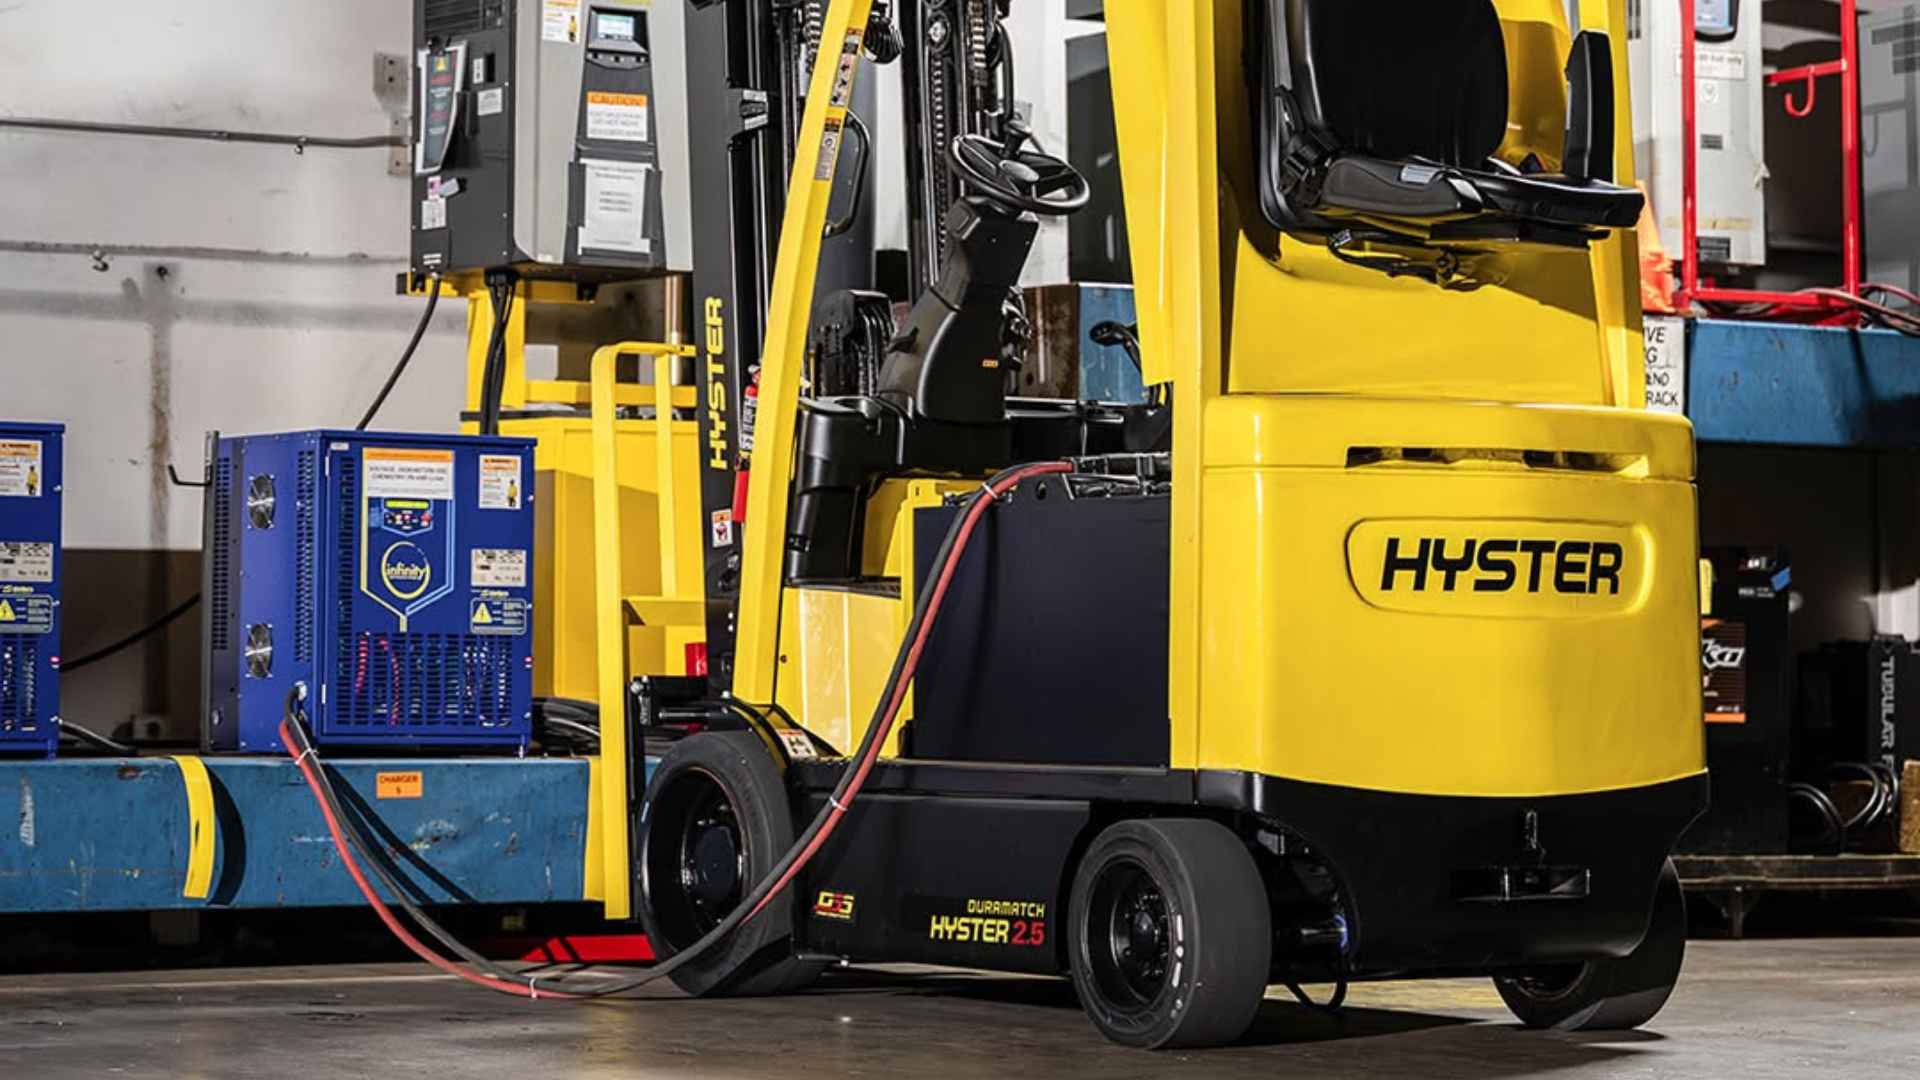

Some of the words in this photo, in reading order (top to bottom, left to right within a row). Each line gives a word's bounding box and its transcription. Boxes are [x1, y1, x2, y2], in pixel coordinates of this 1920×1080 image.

[1643, 326, 1665, 343] VE
[705, 296, 727, 470] HYSTER
[386, 562, 430, 578] infinity
[1380, 537, 1623, 594] HYSTER
[966, 898, 1046, 918] DURAMATCH
[929, 914, 1010, 945] HYSTER
[1010, 920, 1046, 946] 2.5
